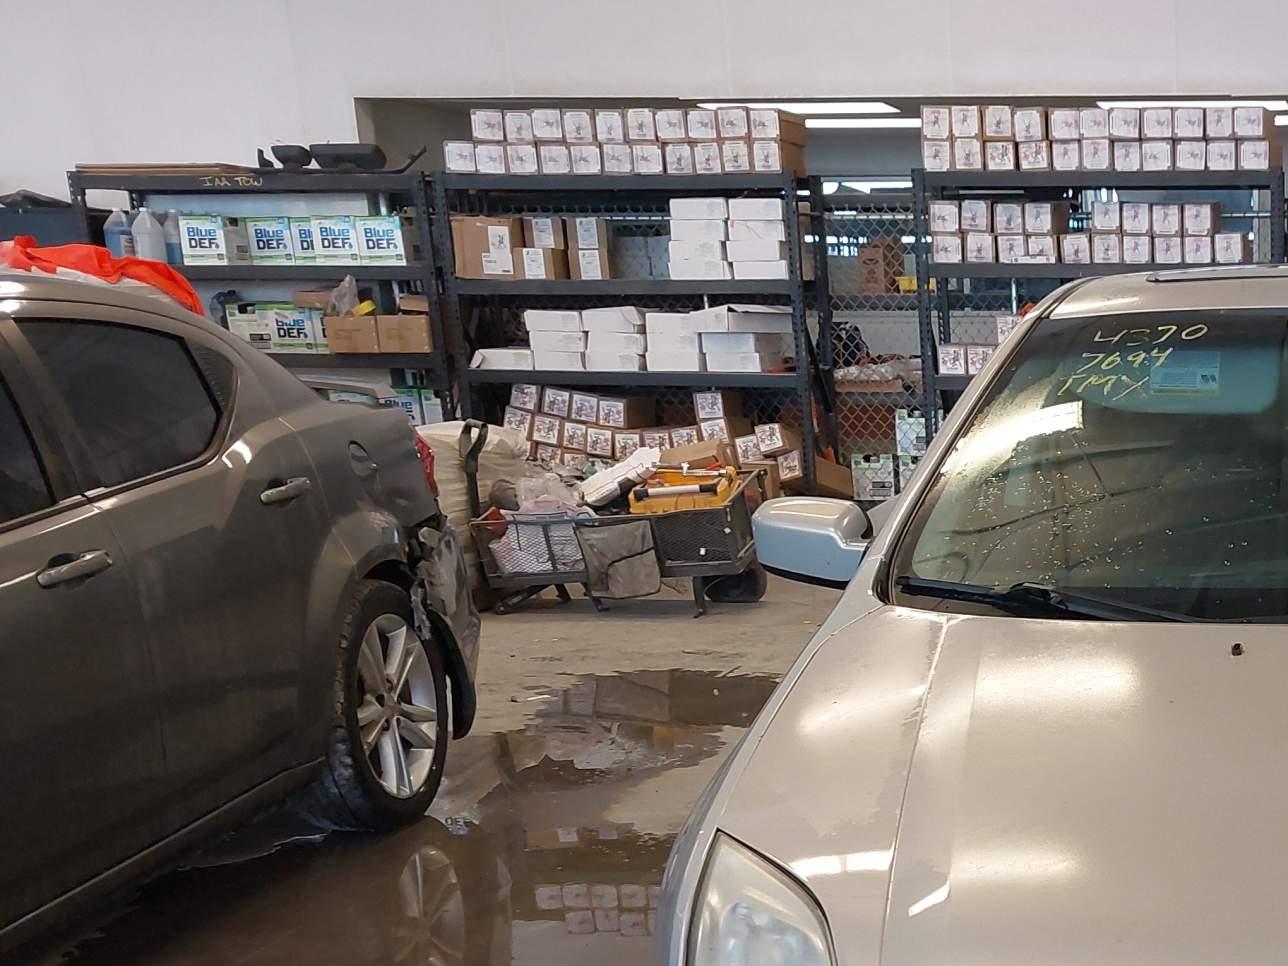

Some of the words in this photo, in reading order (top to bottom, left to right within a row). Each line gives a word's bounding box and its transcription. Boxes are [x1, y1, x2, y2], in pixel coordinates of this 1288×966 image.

[234, 175, 263, 187] TOW
[186, 226, 217, 237] Blue
[254, 228, 284, 238] Blue
[319, 226, 350, 237] Blue
[364, 227, 395, 238] Blue
[188, 237, 218, 249] DEF
[256, 239, 285, 250] DEF
[321, 237, 351, 249] DEF
[365, 238, 396, 250] DEF
[277, 327, 305, 338] DEF
[1077, 347, 1174, 374] 7694
